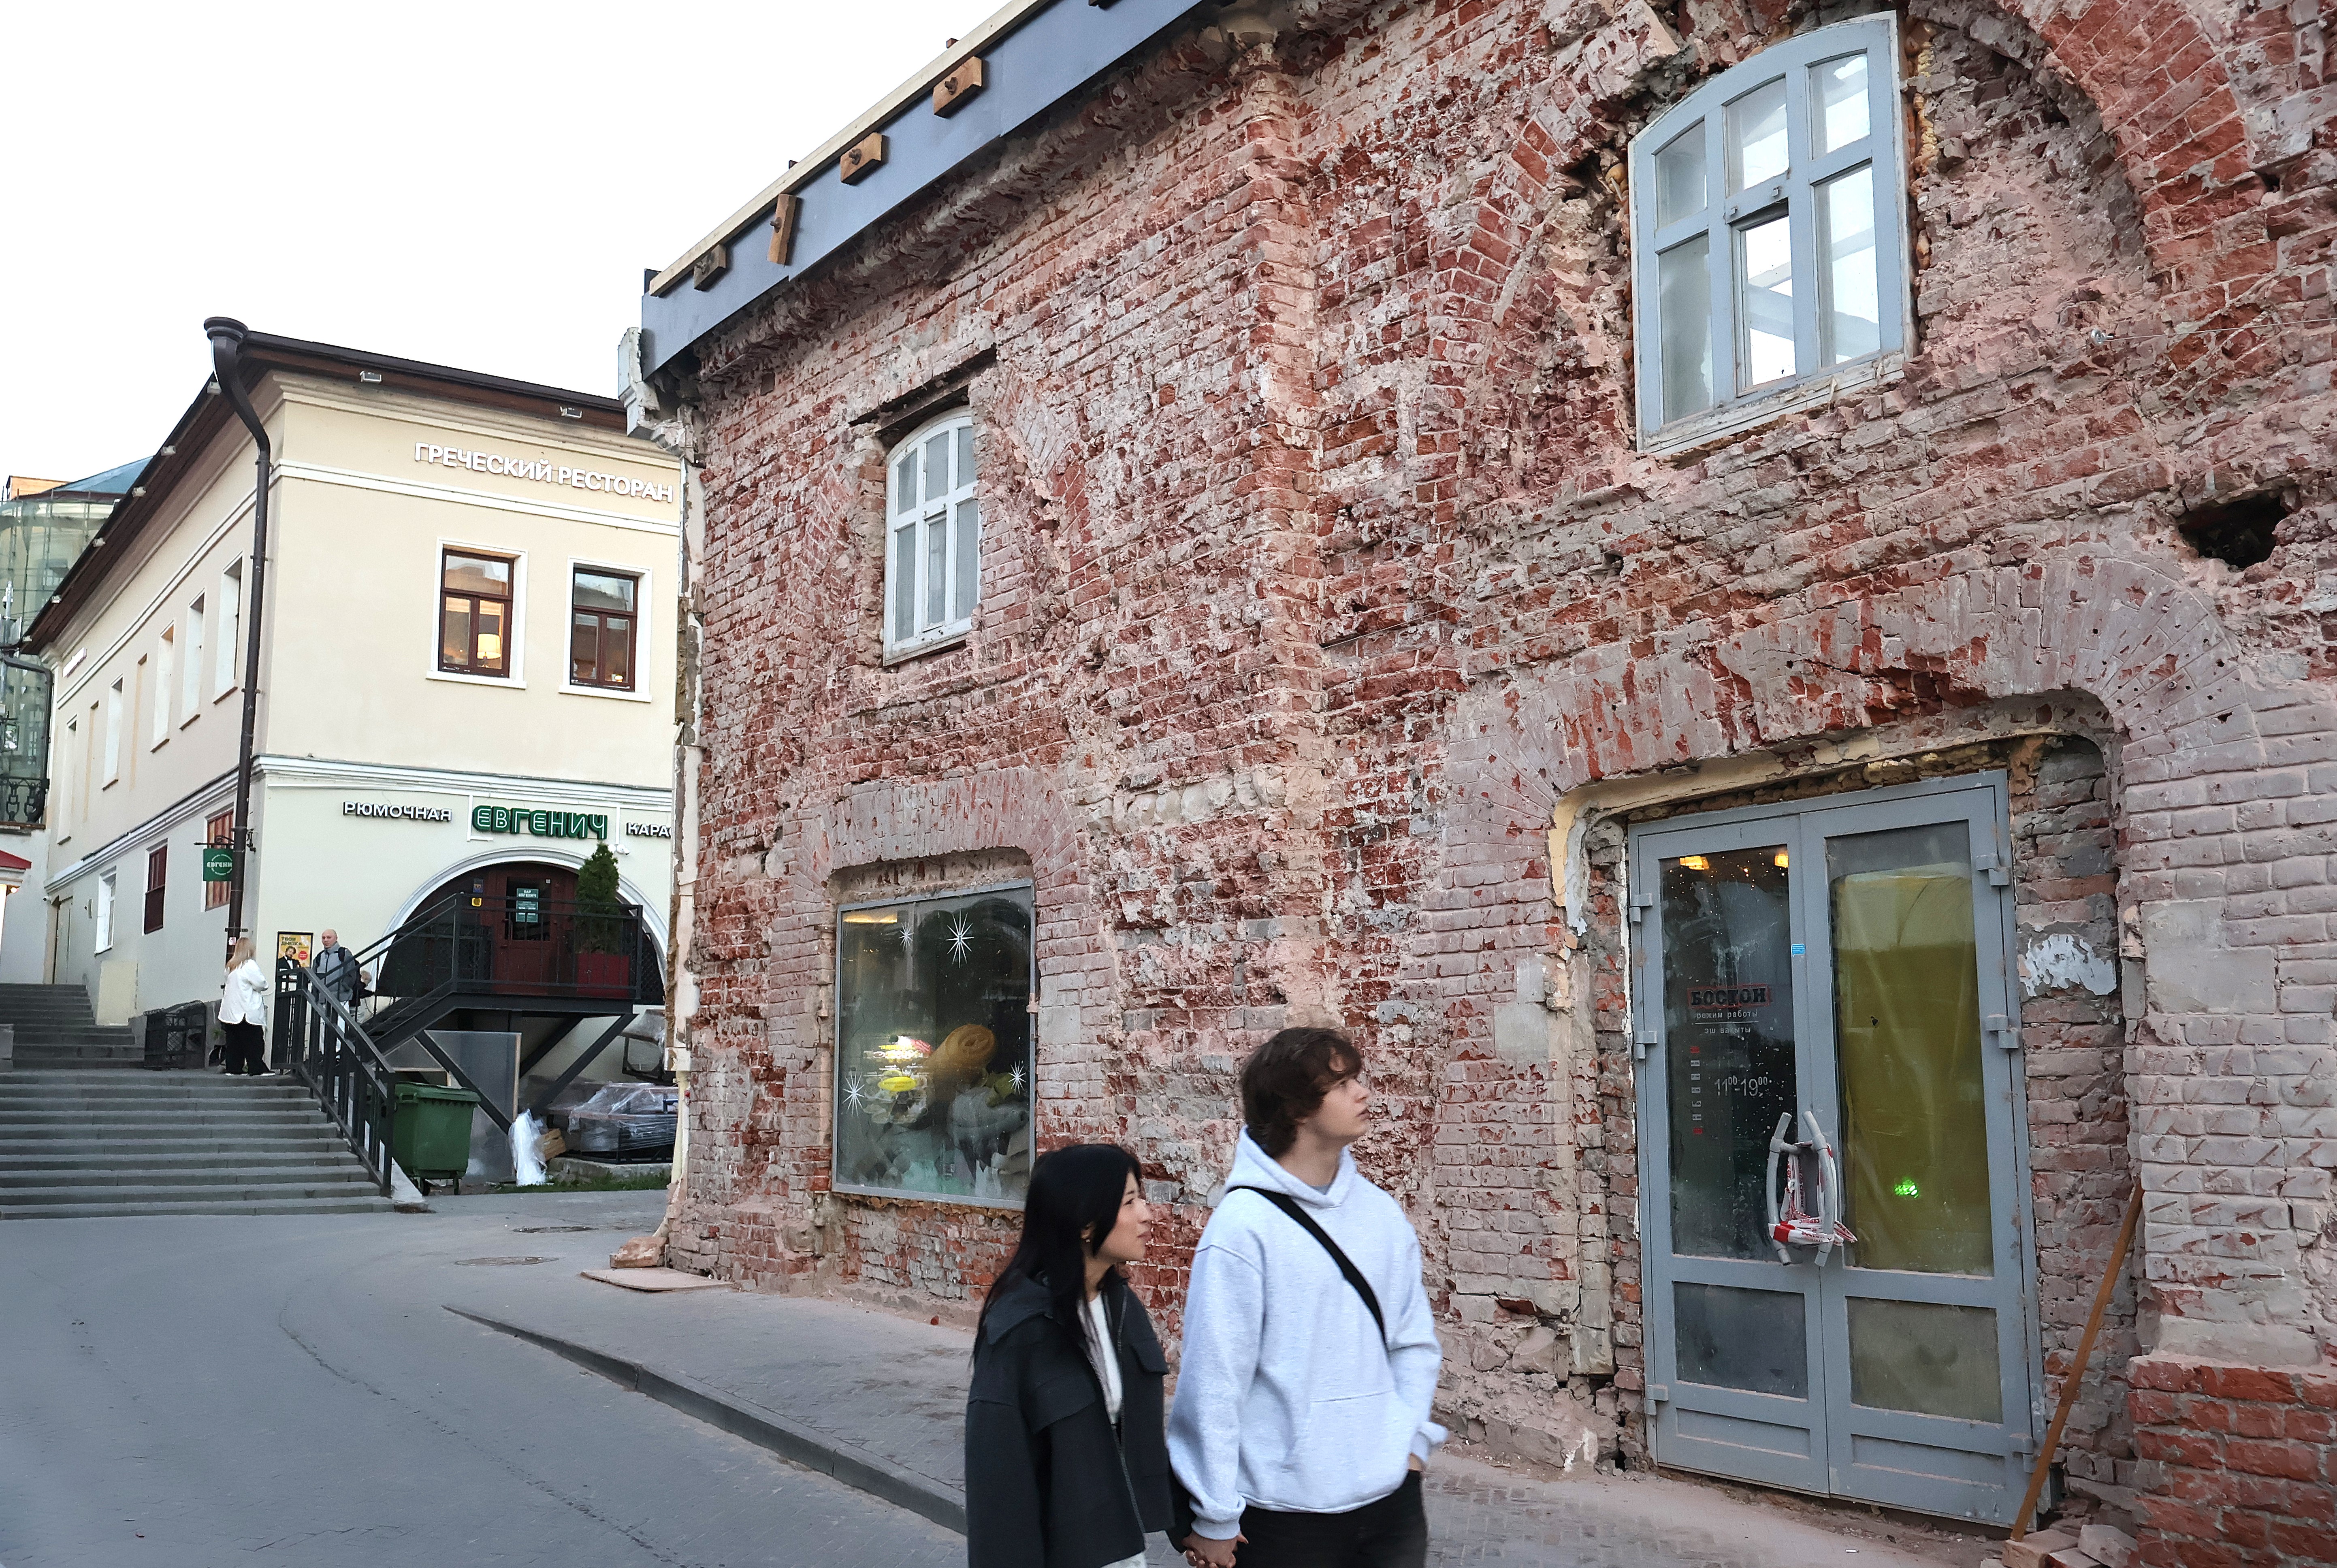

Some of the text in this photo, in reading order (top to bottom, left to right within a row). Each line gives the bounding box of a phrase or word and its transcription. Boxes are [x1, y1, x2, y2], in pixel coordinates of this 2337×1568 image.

[415, 442, 673, 503] ГРЕЧЕСКИЙ РЕСТОРАН
[343, 801, 452, 822] РЮМОЧНАЯ
[472, 805, 608, 839] ЕВГЕНИЧ
[1691, 988, 1766, 1006] БОСТОН
[1727, 1009, 1758, 1019] работы
